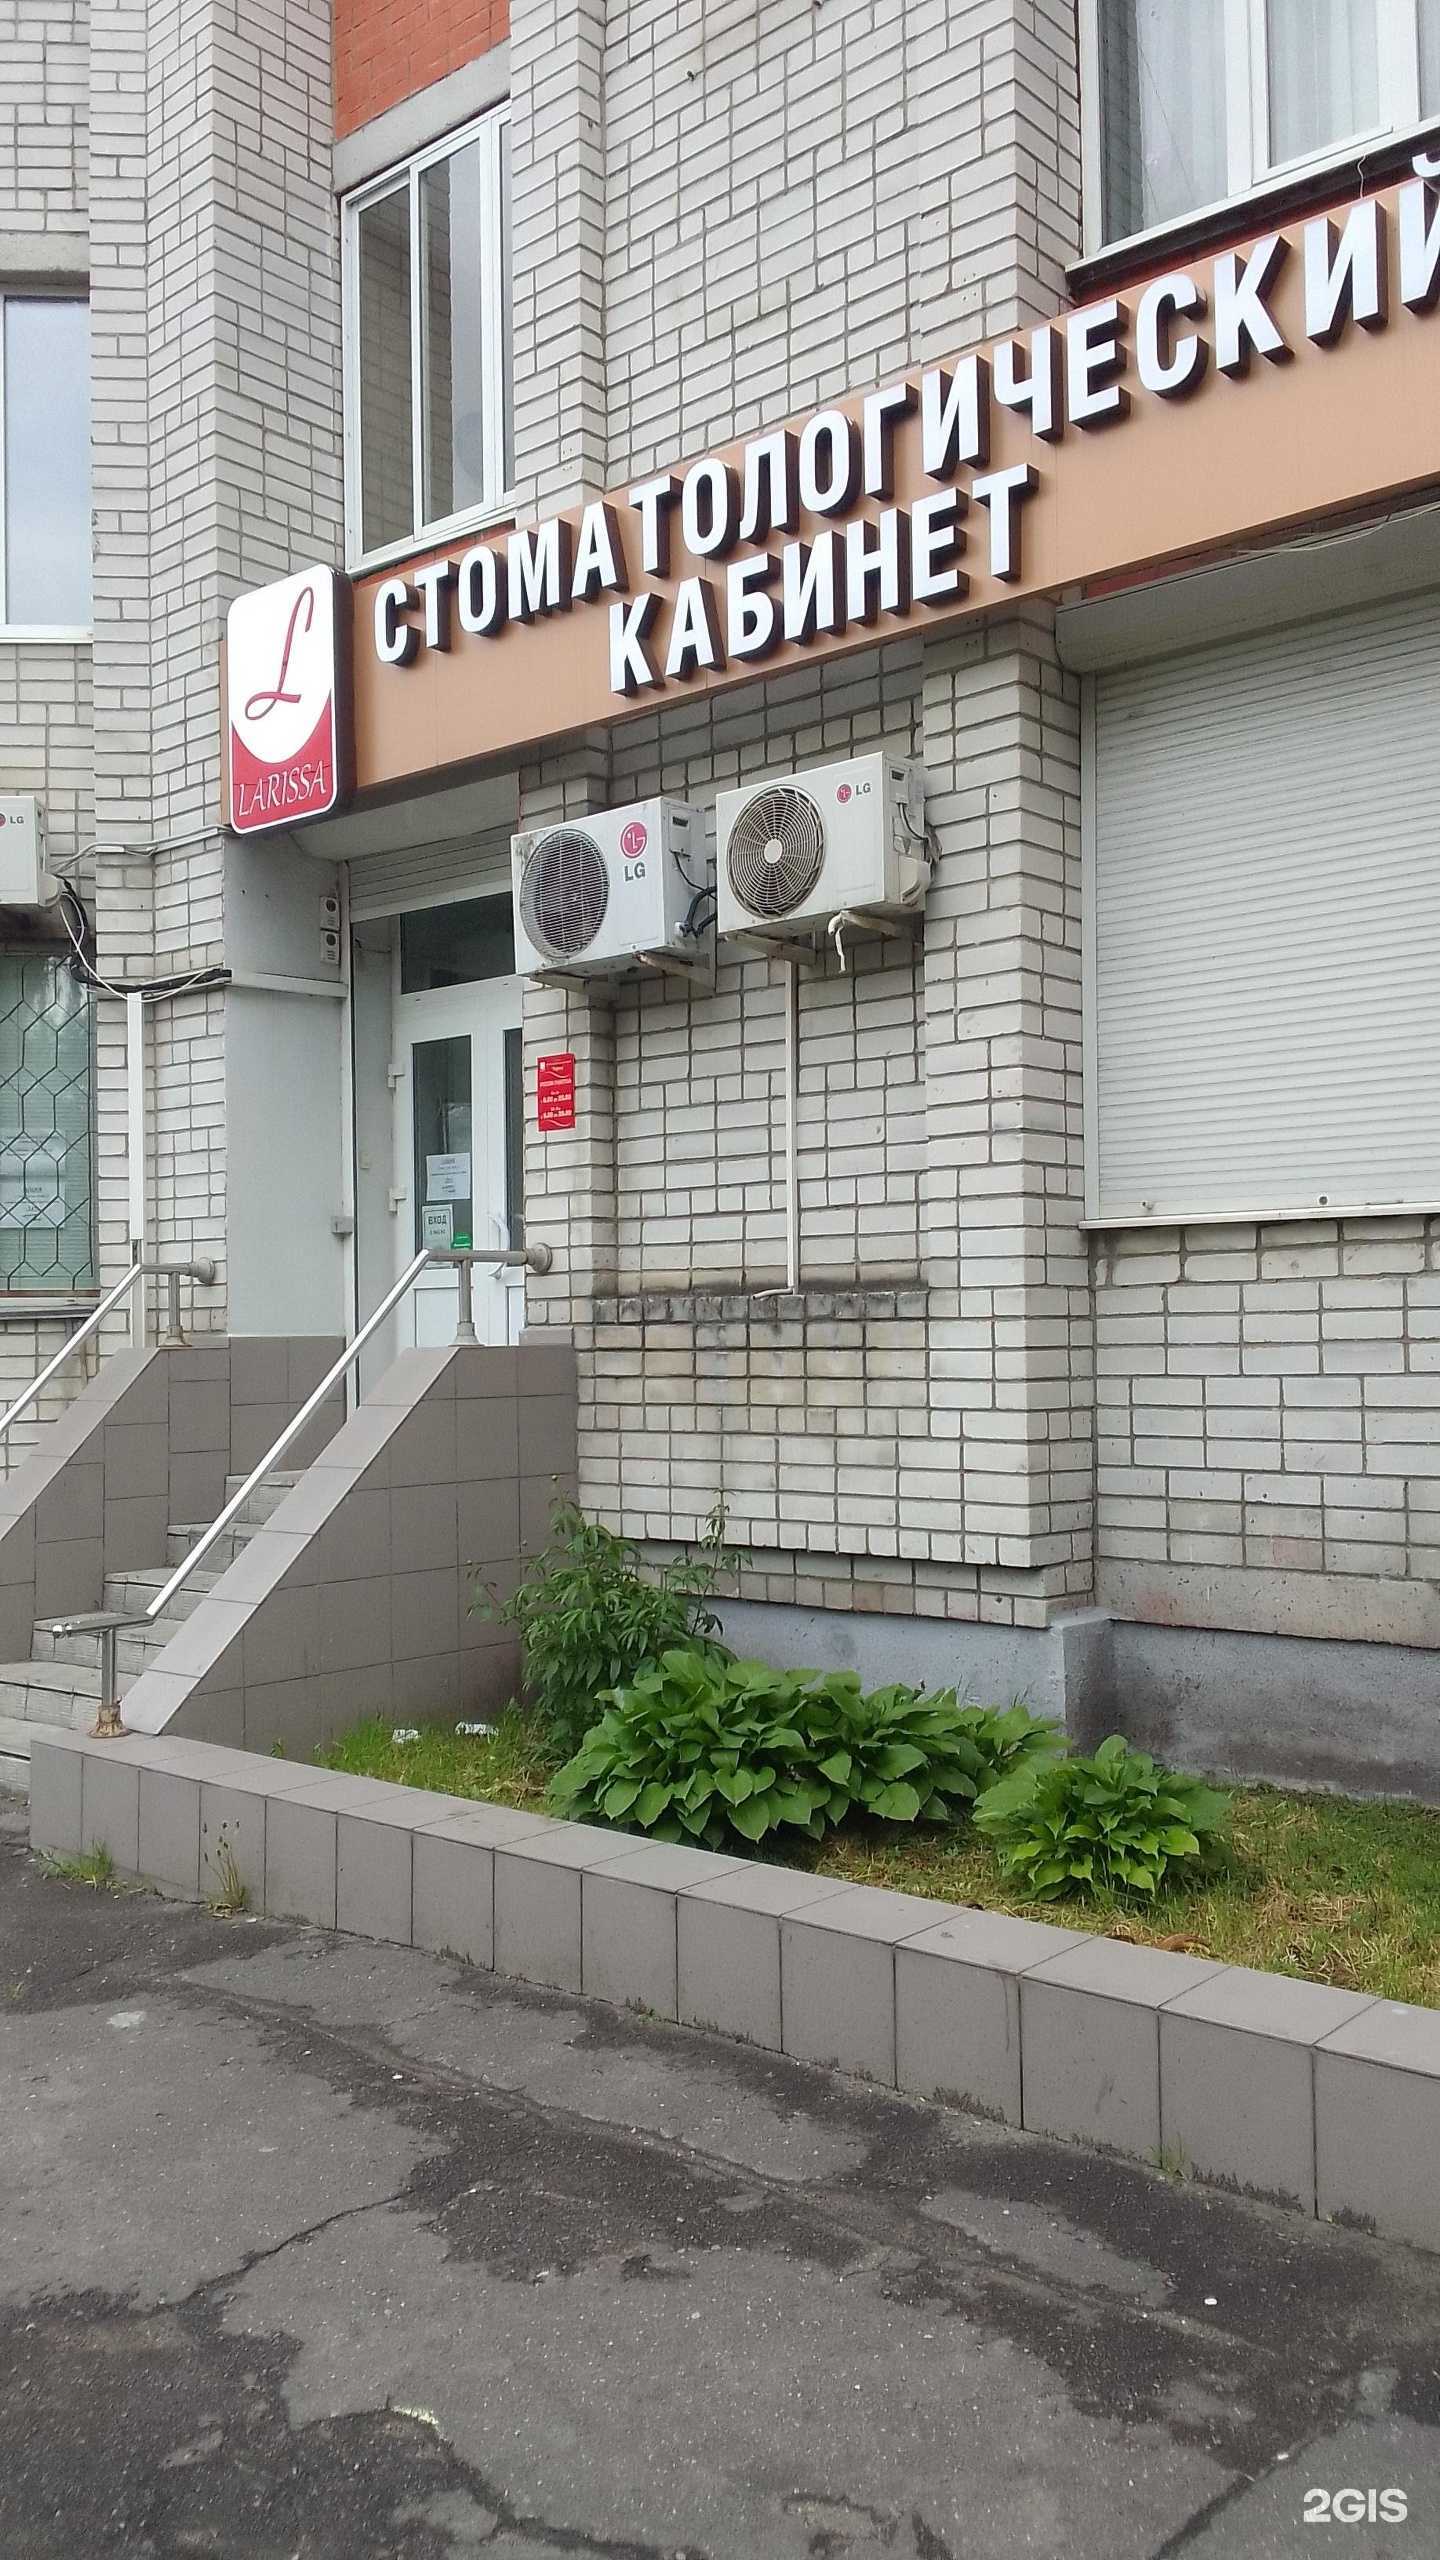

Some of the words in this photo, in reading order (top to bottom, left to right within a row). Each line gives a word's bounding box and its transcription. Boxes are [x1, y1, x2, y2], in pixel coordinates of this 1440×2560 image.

[608, 463, 1030, 693] КАБИНЕТ
[238, 760, 328, 817] LARISSA
[855, 782, 871, 796] LG
[9, 815, 25, 824] LG
[624, 861, 646, 881] LG
